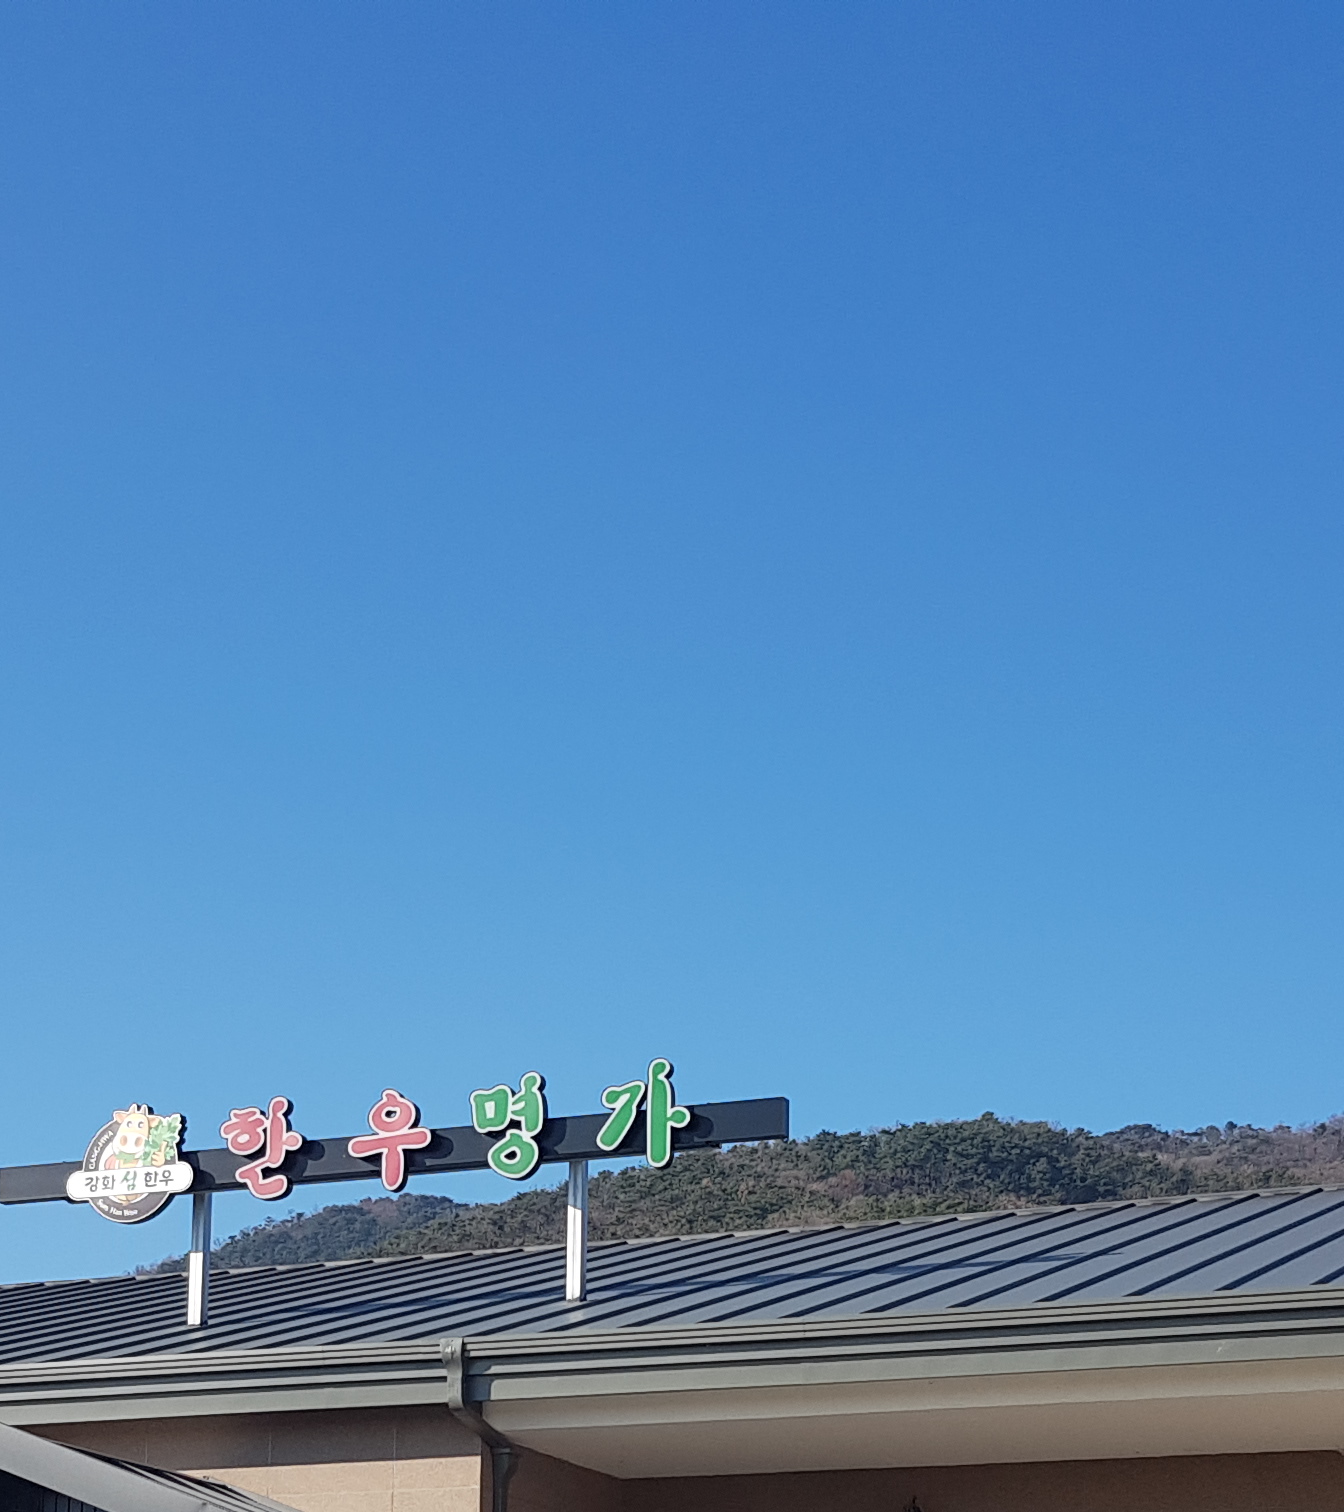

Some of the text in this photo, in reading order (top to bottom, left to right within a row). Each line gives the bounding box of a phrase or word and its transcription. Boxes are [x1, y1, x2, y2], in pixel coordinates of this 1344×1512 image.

[220, 1057, 690, 1200] 한우명가
[84, 1170, 175, 1192] 강화 섬 한우
